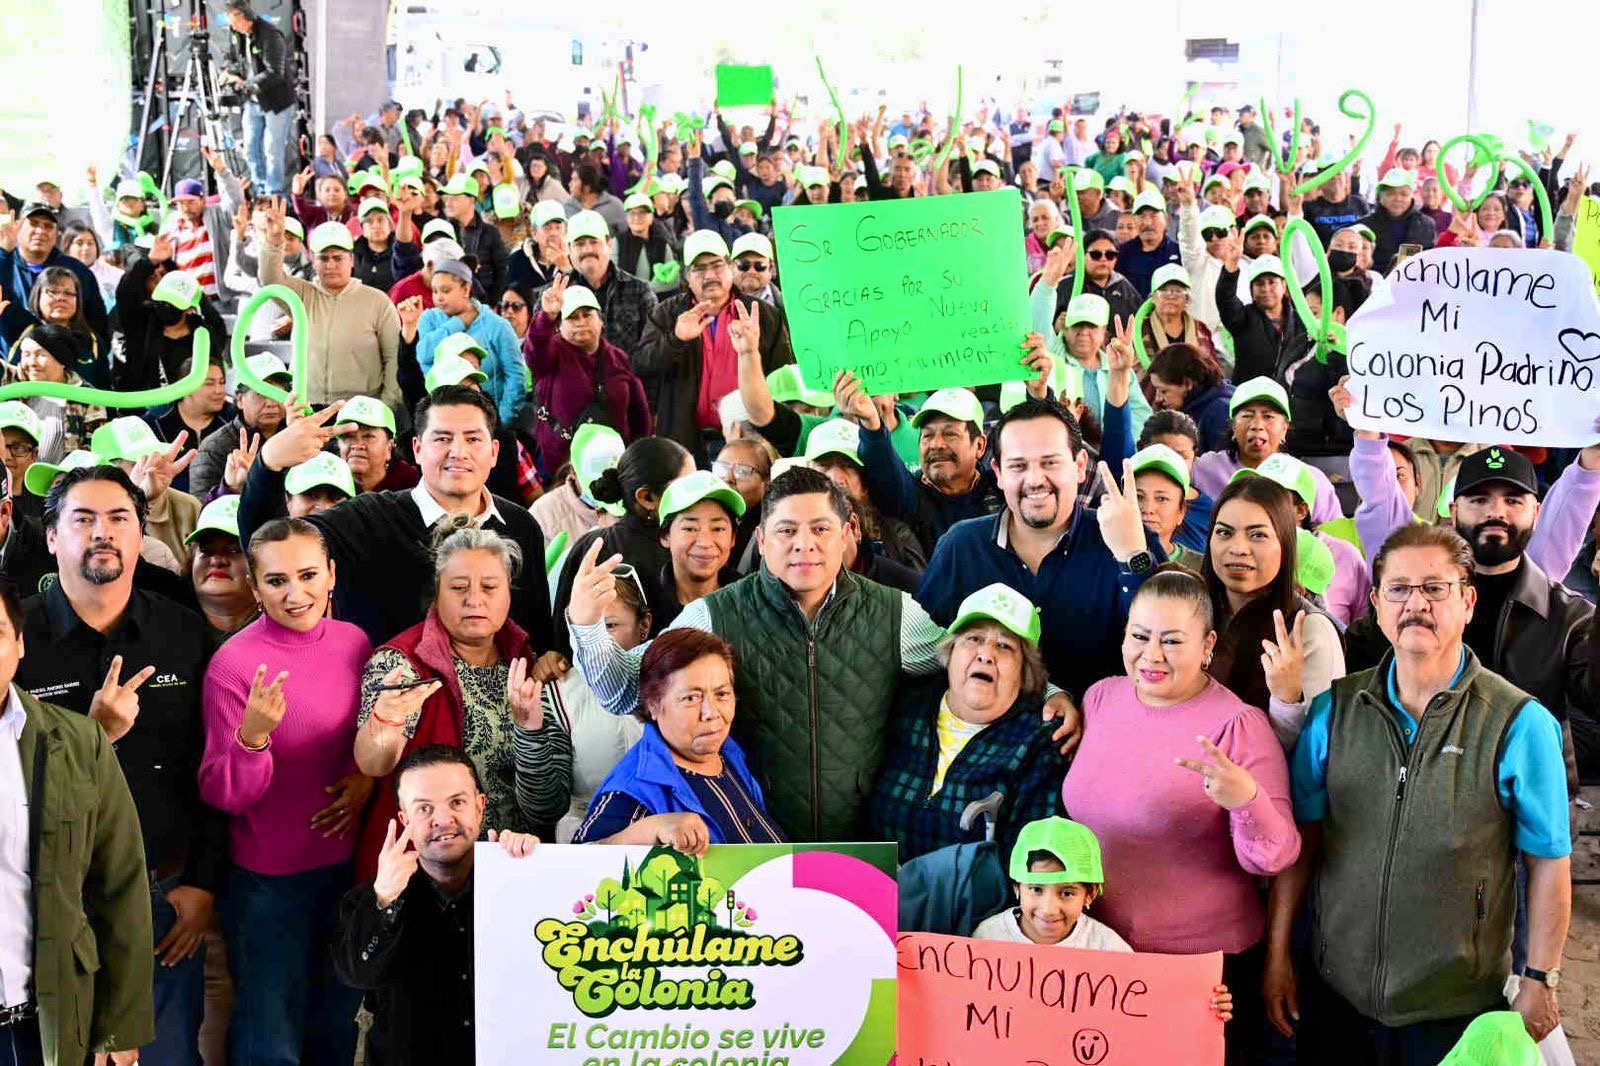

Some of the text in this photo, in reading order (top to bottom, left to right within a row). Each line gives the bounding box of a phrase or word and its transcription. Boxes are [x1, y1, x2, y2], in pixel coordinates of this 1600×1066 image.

[1420, 299, 1461, 332] Mi
[1349, 342, 1464, 379] Colonia
[156, 673, 178, 684] CEA
[535, 918, 803, 969] Enchúlame
[620, 962, 642, 981] la
[558, 964, 756, 1018] Colonia
[546, 1022, 826, 1049] El Cambio se vive
[965, 1002, 1013, 1040] Mi
